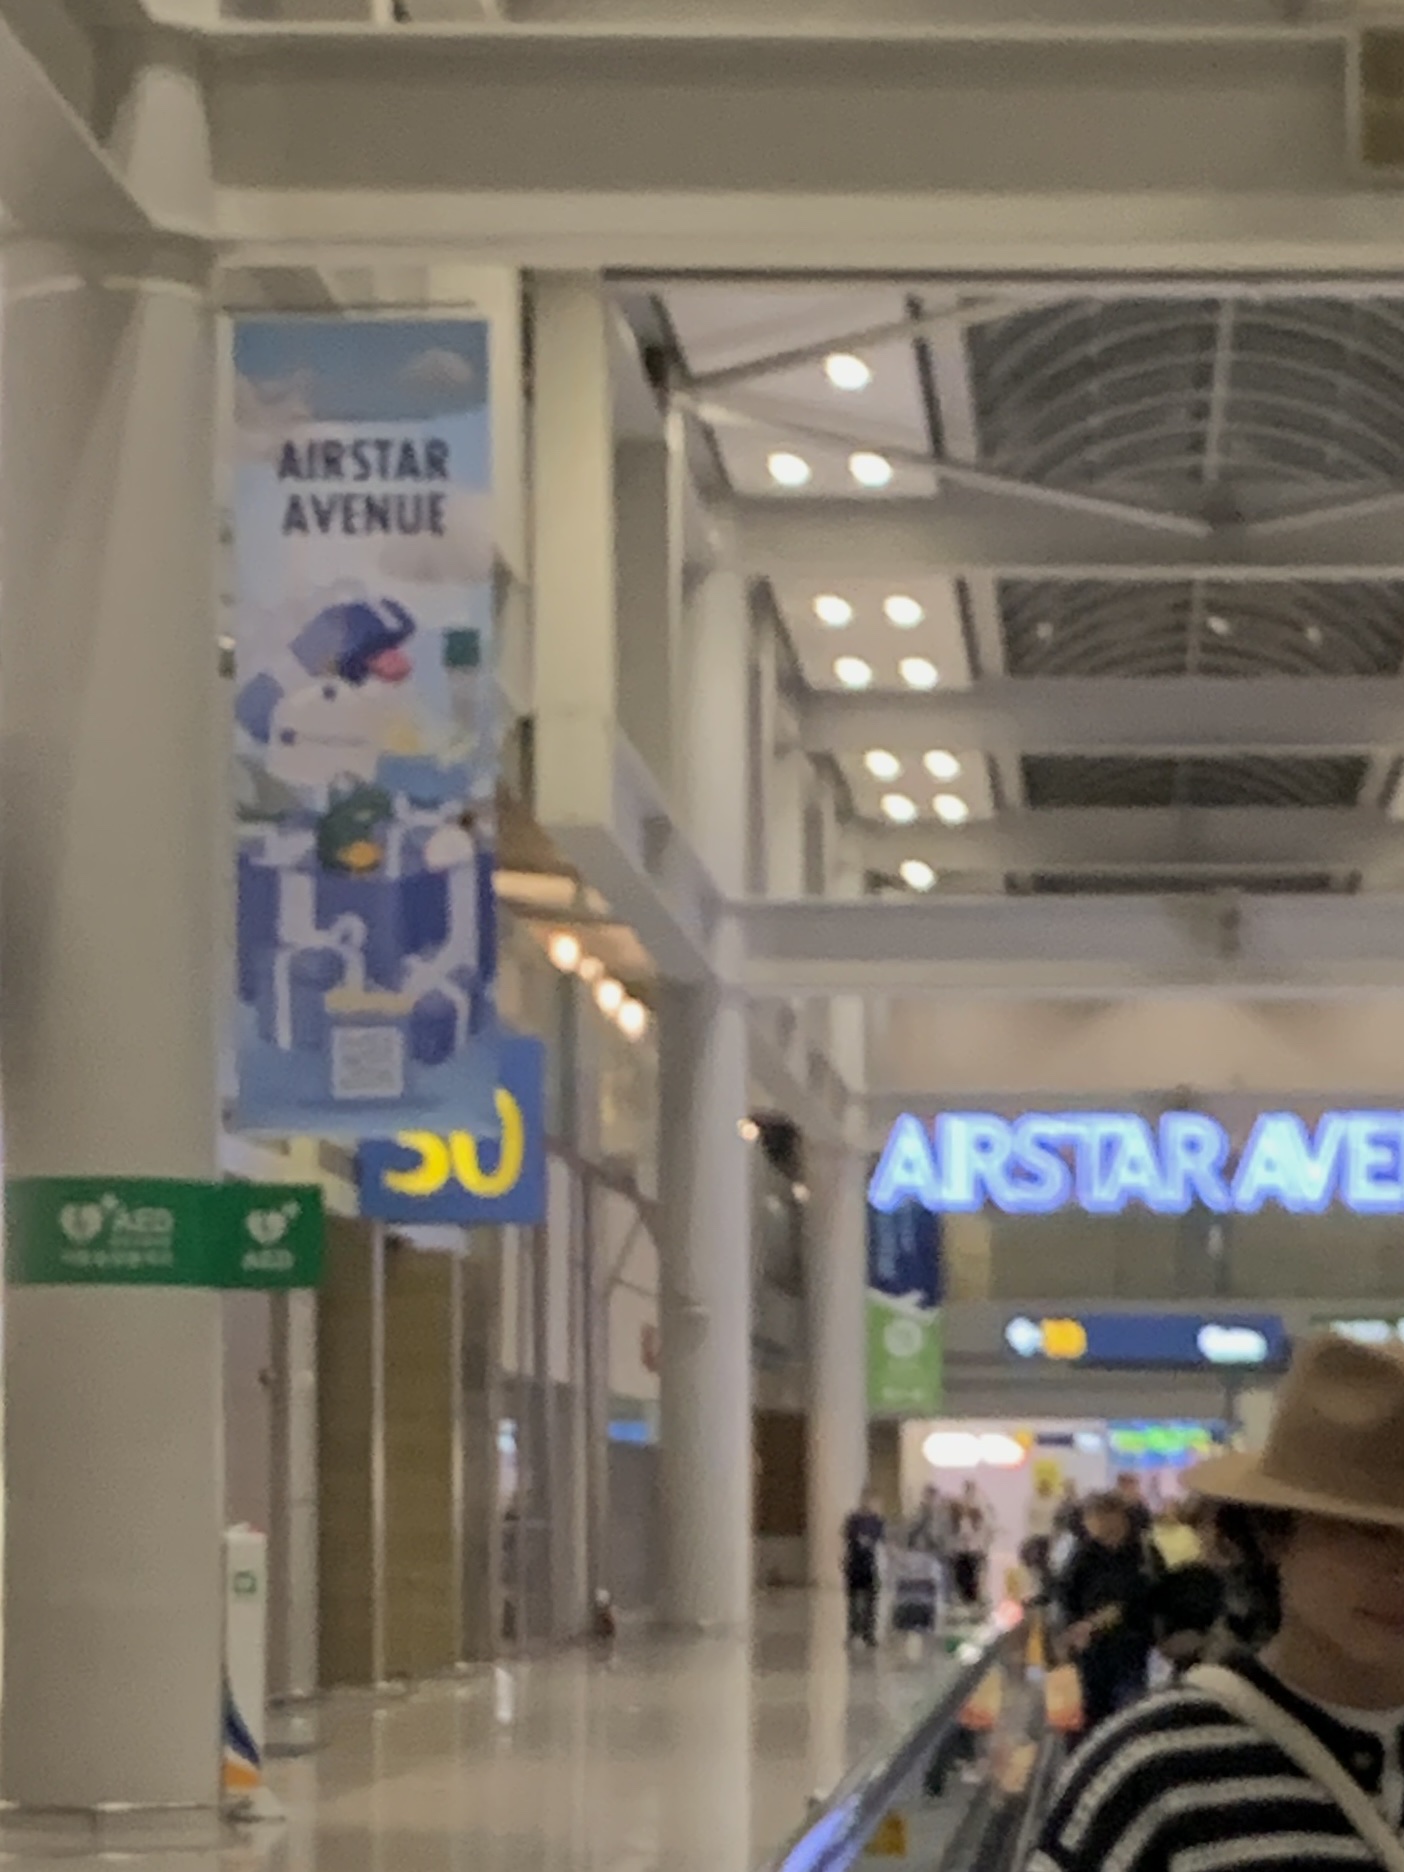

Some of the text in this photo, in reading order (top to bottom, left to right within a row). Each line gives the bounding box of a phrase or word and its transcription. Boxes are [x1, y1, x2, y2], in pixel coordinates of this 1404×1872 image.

[277, 438, 450, 482] AIRSTAR
[282, 492, 446, 536] AVENUE
[868, 1111, 1234, 1214] AIRSTAR
